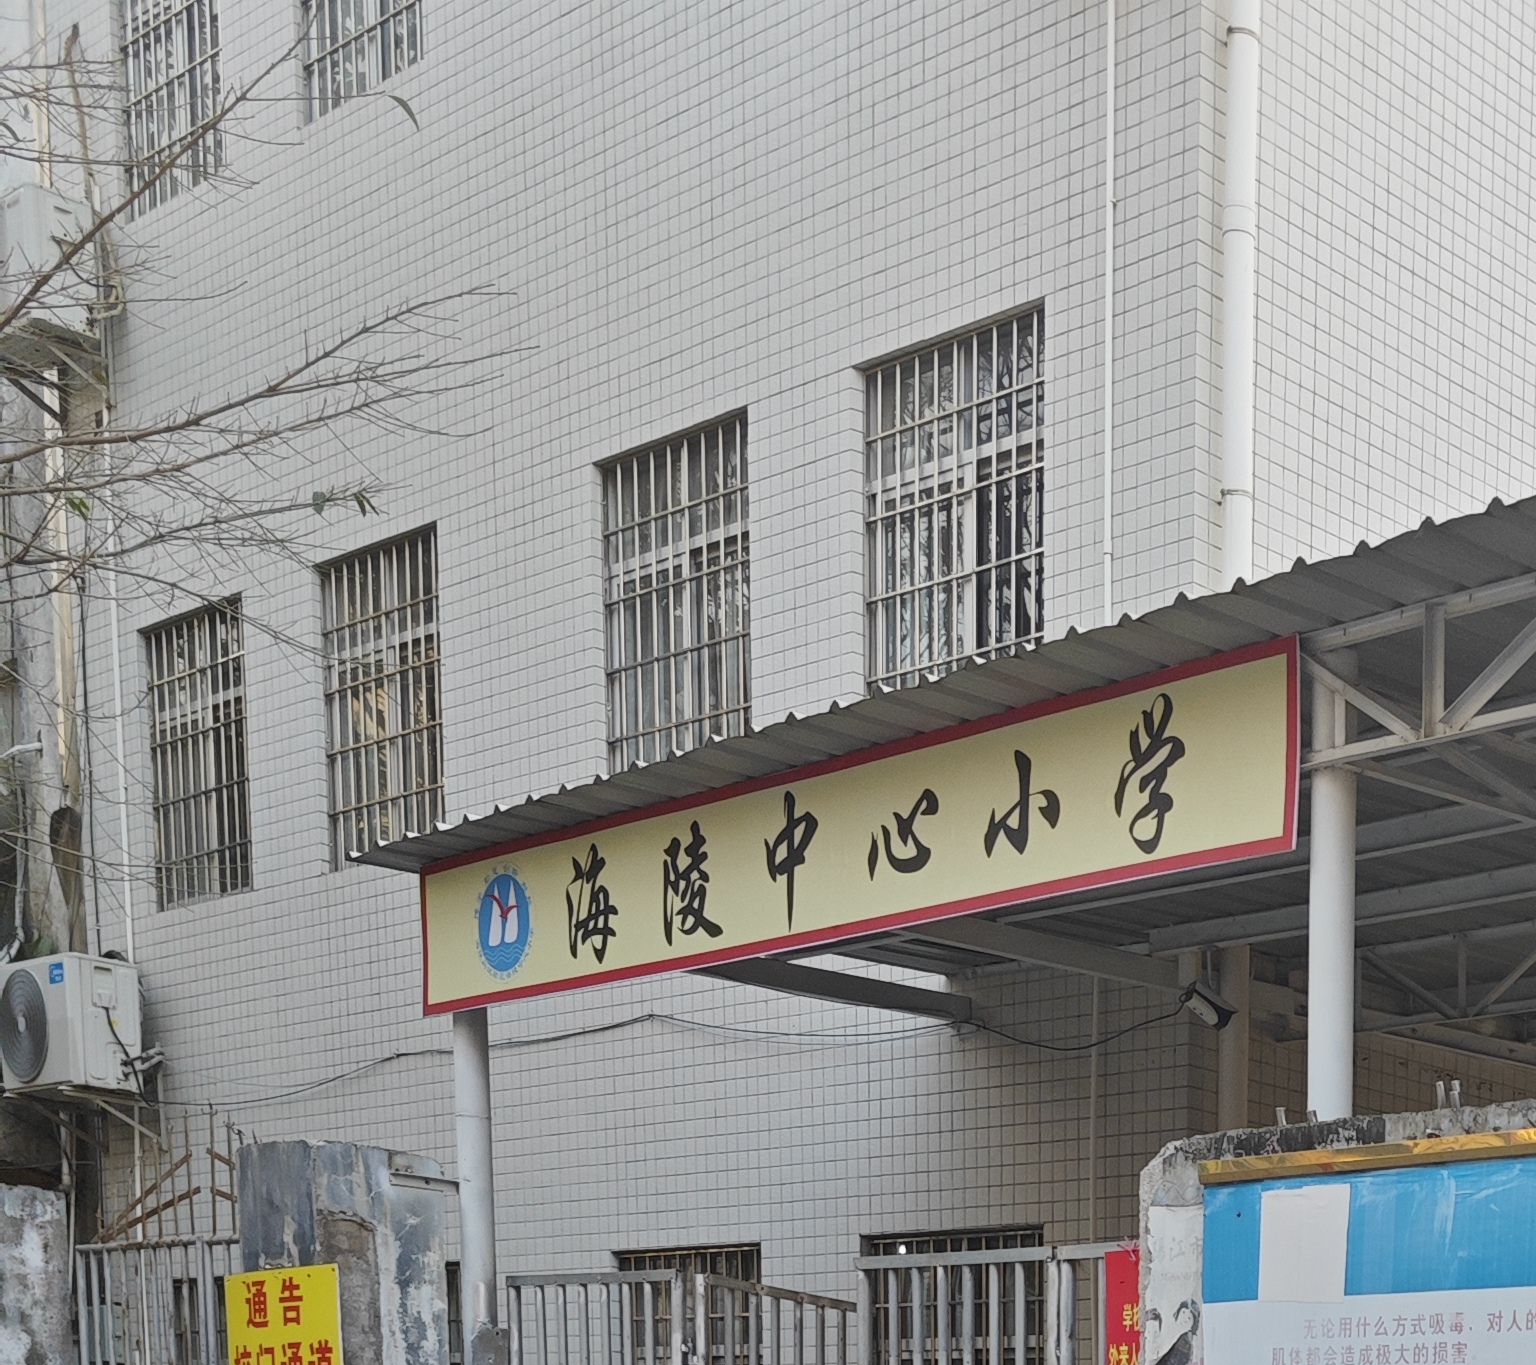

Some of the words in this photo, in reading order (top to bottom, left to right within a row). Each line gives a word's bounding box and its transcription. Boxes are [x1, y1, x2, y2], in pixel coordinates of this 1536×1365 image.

[566, 693, 1187, 964] 海陵中心小学
[245, 1276, 304, 1329] 通告
